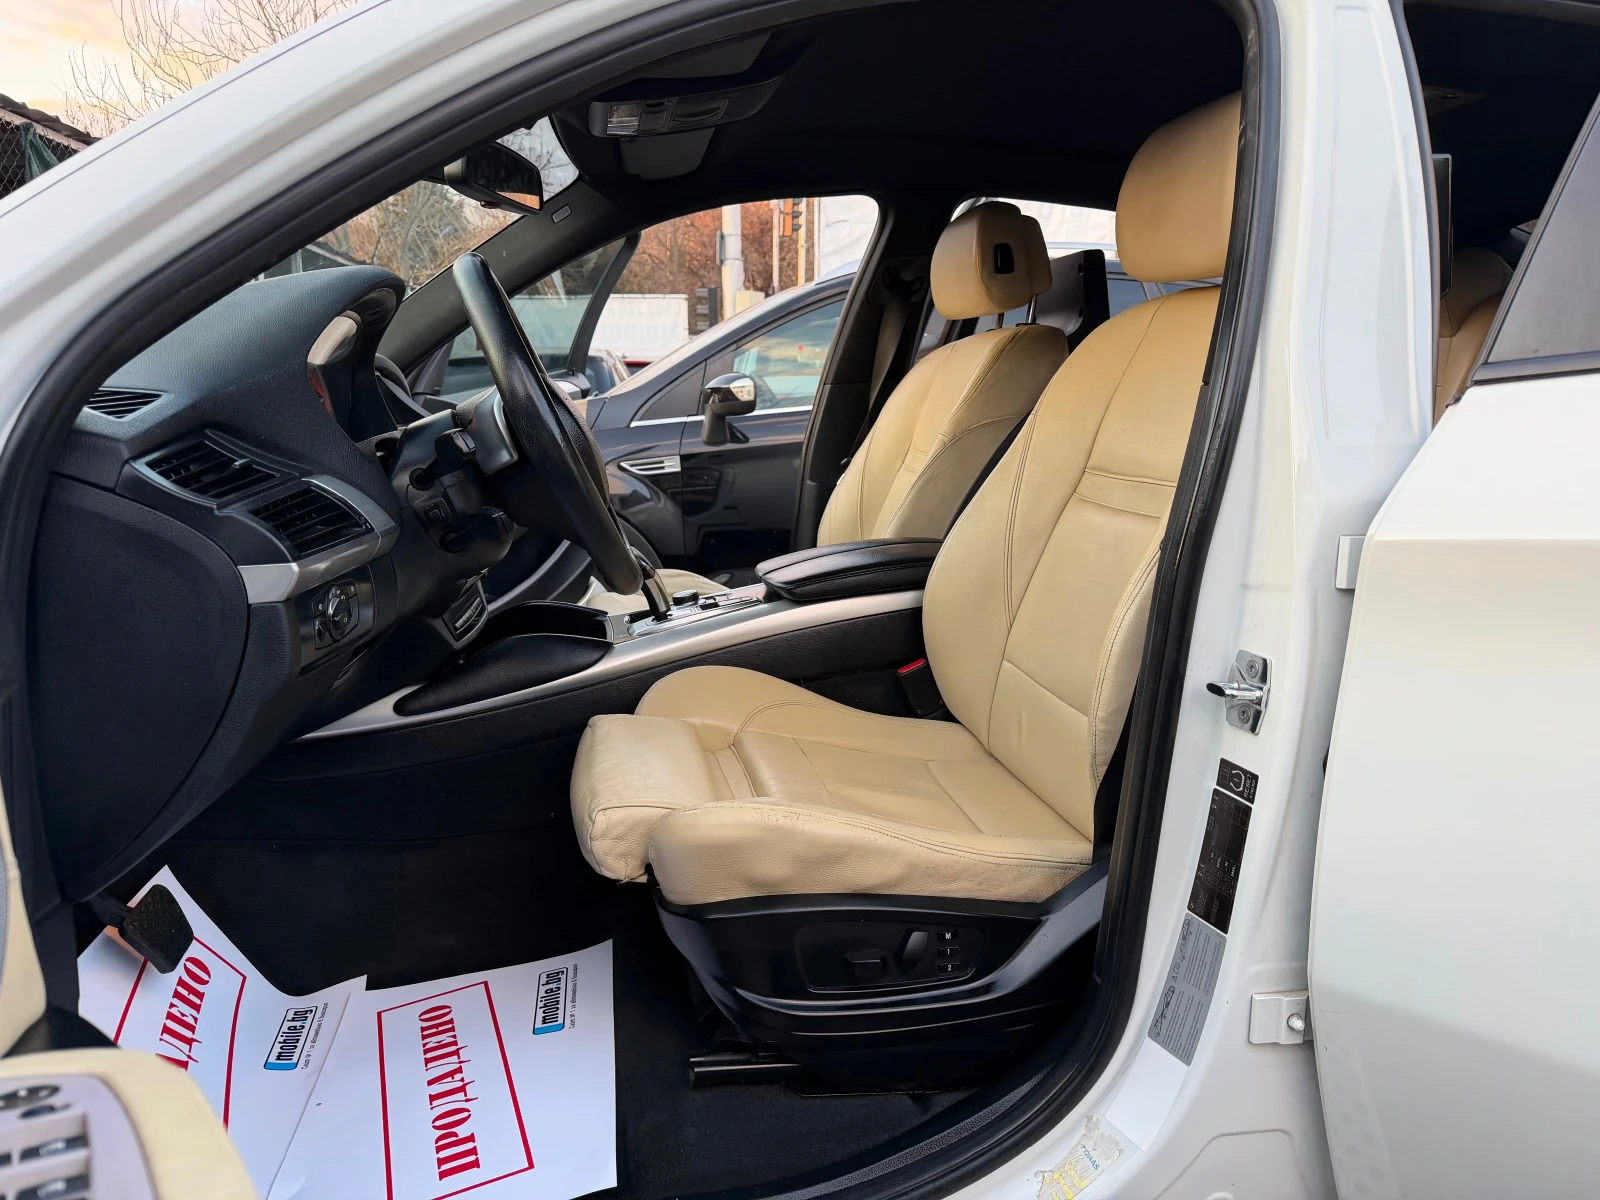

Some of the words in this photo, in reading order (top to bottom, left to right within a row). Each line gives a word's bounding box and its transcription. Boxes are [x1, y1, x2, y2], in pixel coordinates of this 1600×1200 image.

[1243, 773, 1252, 798] RESET
[945, 932, 952, 940] M
[538, 970, 565, 1025] mobile.bg
[274, 1009, 314, 1062] mobile.bg
[418, 1004, 481, 1182] ПРОДАДЕНО
